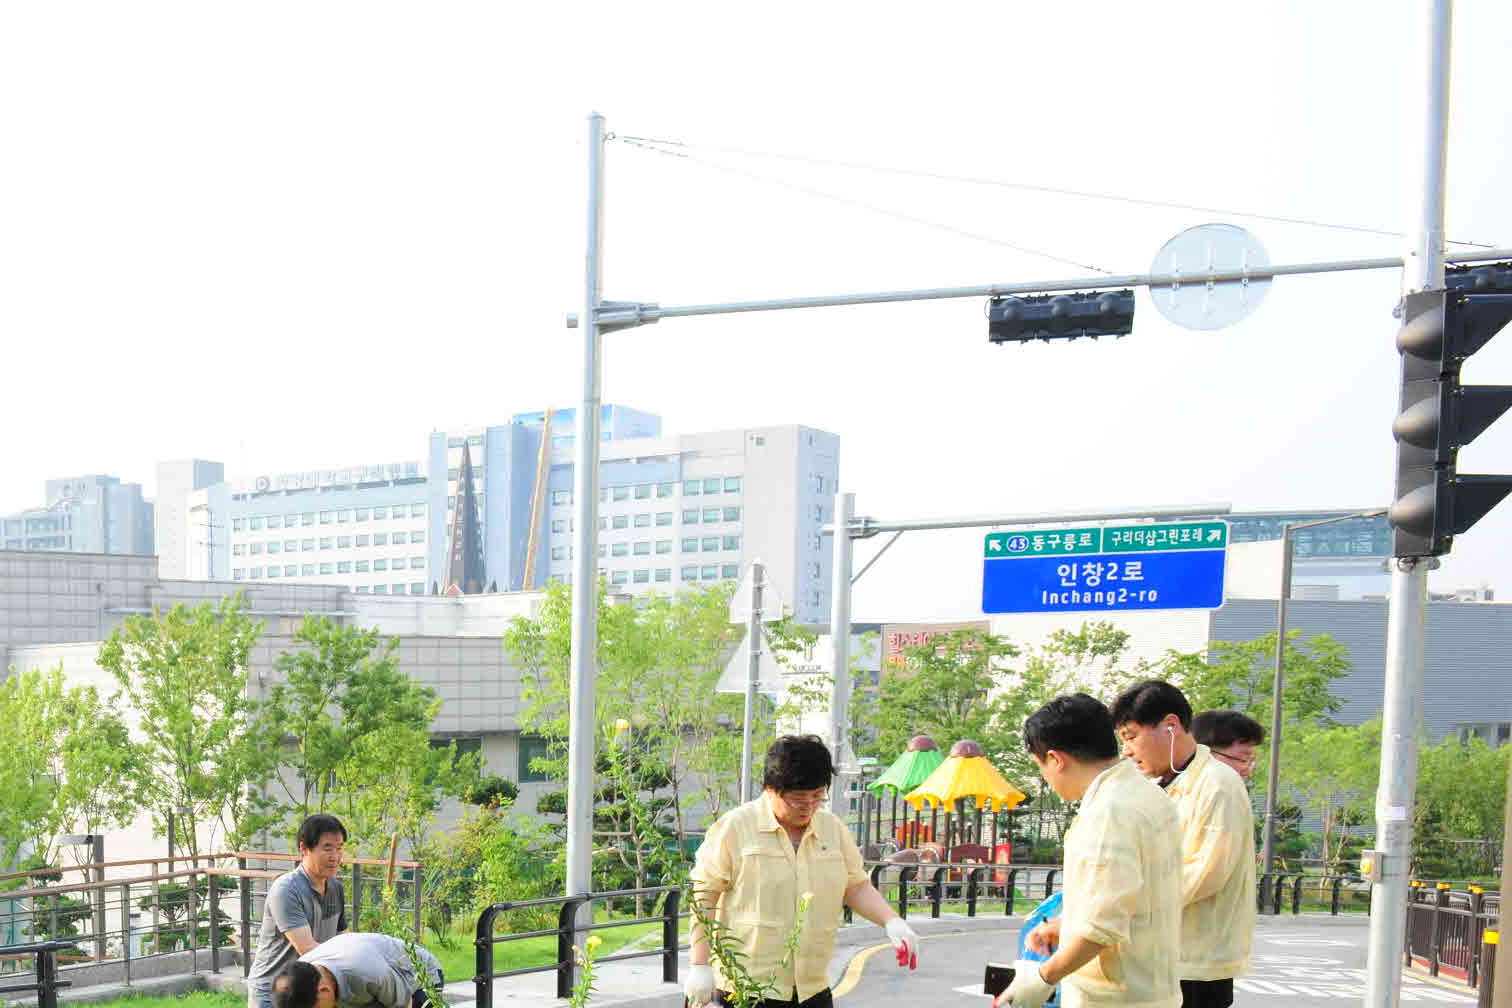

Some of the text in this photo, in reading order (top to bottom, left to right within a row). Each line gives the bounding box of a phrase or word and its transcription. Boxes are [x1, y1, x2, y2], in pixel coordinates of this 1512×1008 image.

[1031, 532, 1094, 552] 동구릉로
[1056, 560, 1145, 587] 인창2로
[1041, 587, 1159, 606] Inchang2-ro
